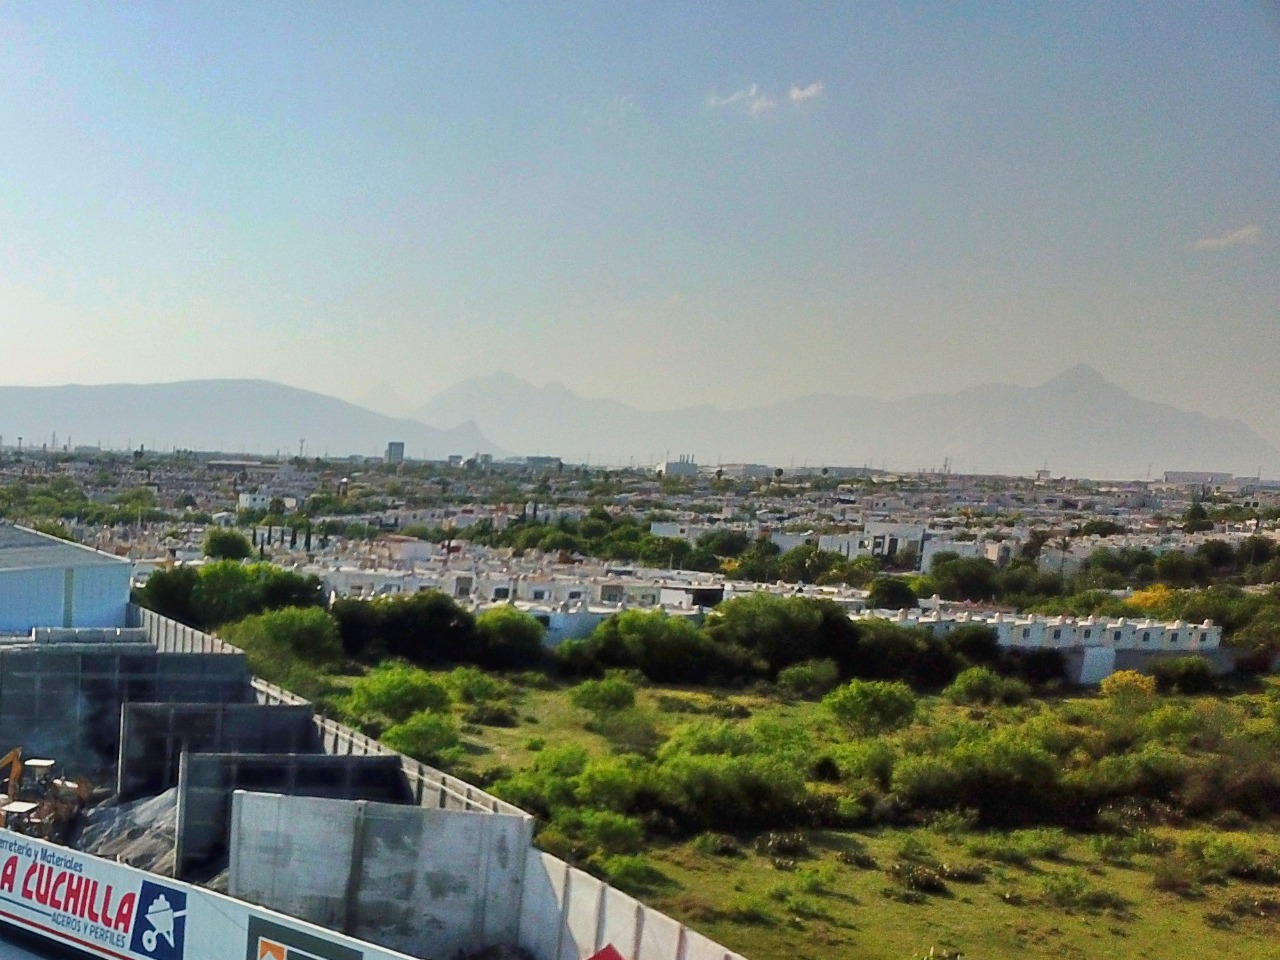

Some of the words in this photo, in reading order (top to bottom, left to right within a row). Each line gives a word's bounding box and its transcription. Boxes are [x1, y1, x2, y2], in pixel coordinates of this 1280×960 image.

[32, 848, 39, 863] y
[40, 847, 84, 873] Materiales
[21, 862, 137, 934] CUCHILLA
[51, 911, 81, 933] ACEROS
[90, 924, 127, 949] PERFILES
